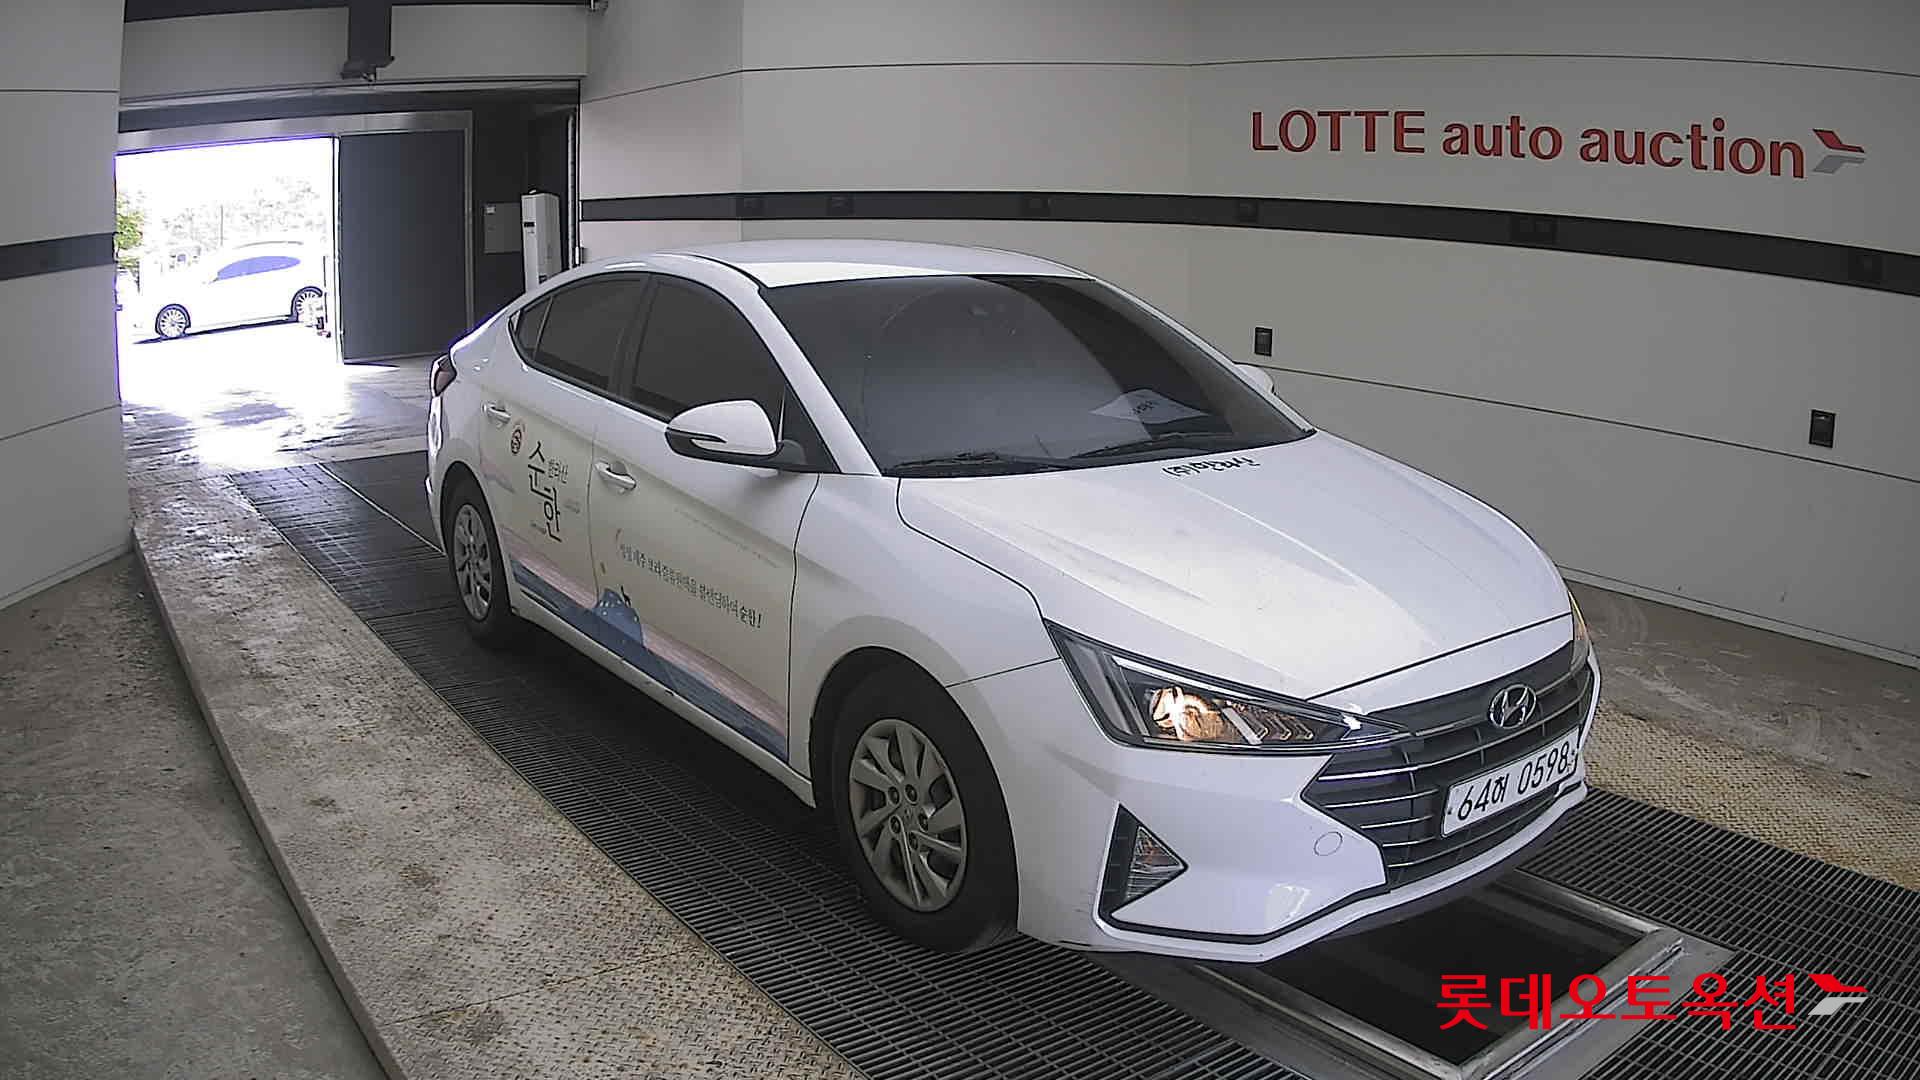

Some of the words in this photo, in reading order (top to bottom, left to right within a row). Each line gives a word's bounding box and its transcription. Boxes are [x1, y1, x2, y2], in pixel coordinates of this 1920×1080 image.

[1251, 110, 1426, 154] LOTTE
[1441, 115, 1563, 161] auto
[1578, 117, 1806, 179] auction
[1517, 741, 1570, 795] 0598
